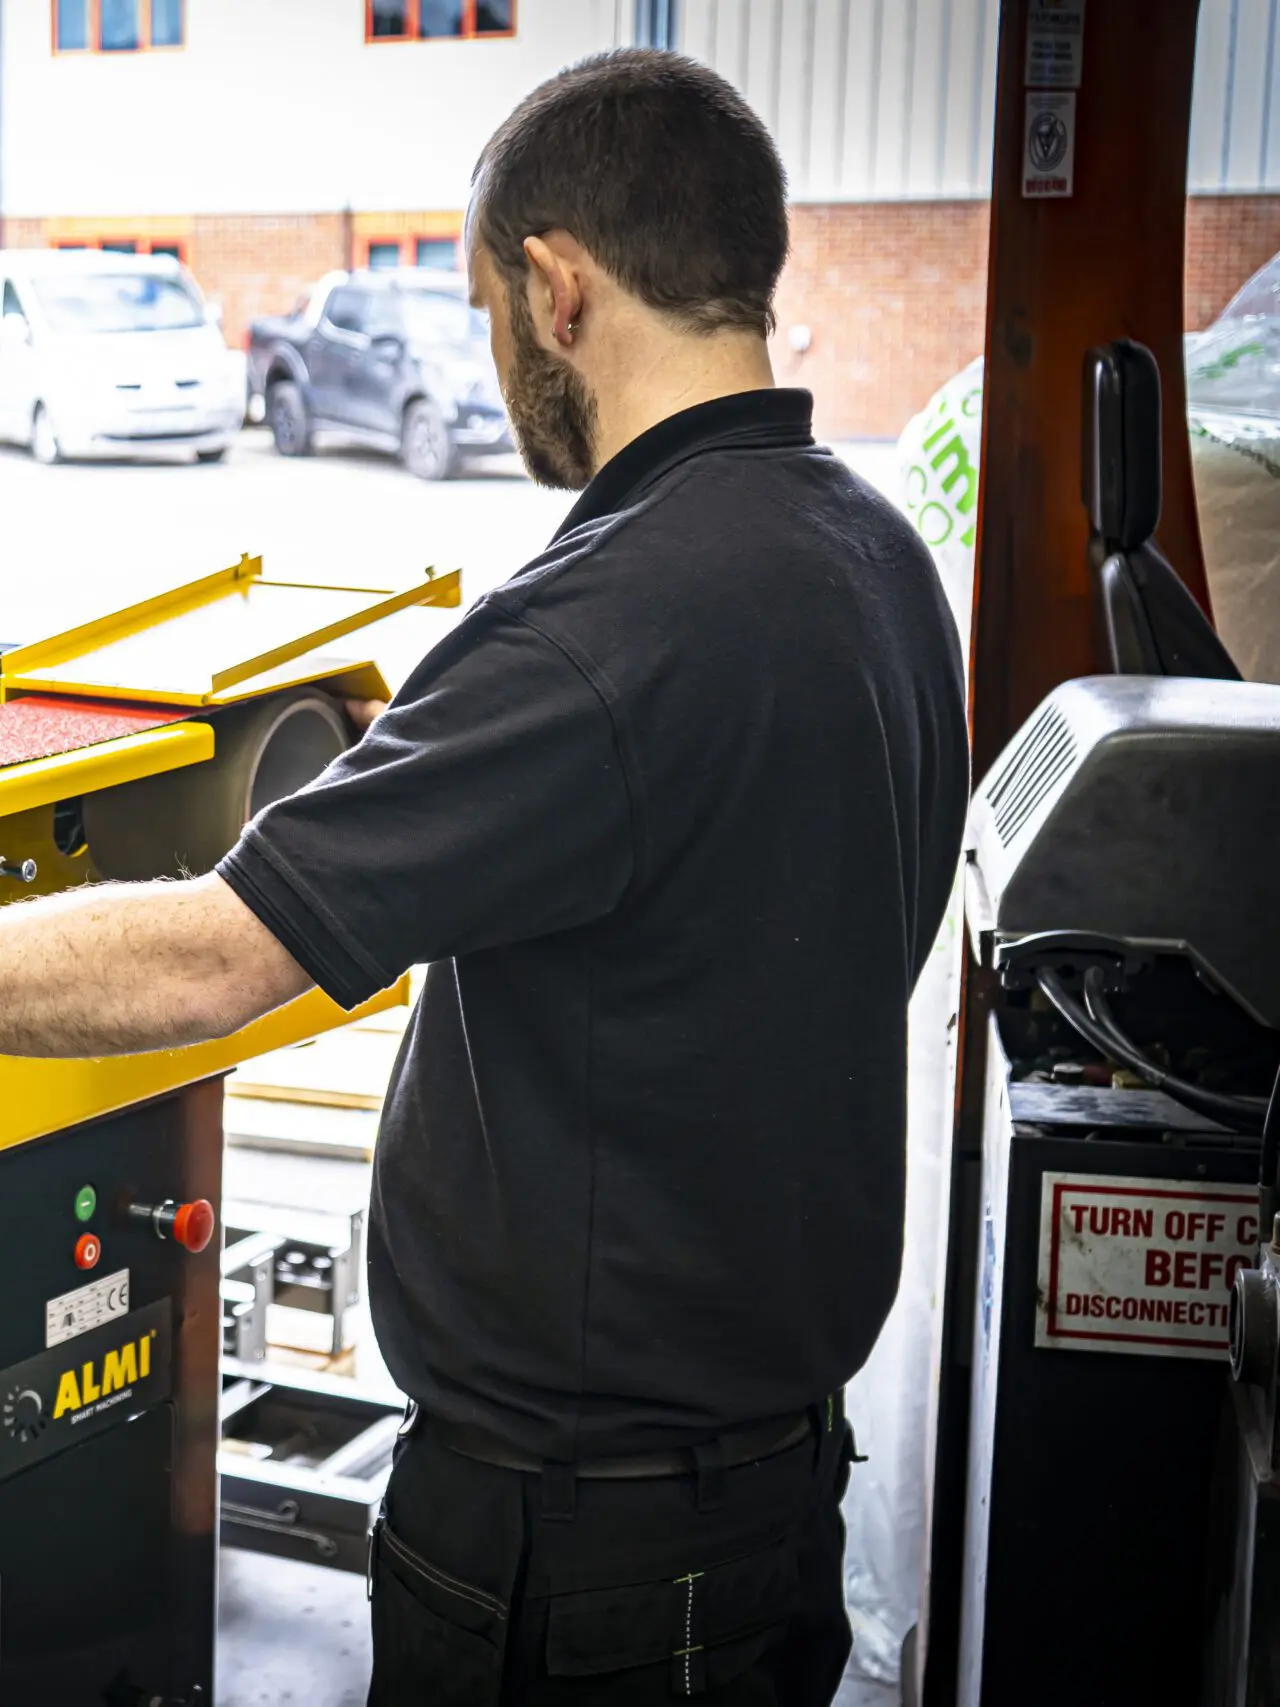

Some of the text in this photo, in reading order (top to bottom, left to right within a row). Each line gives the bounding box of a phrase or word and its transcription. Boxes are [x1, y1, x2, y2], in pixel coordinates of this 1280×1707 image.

[1070, 1204, 1154, 1239] TURN
[1164, 1210, 1226, 1243] OFF
[53, 1335, 151, 1420] ALMI
[70, 1406, 94, 1425] SMART
